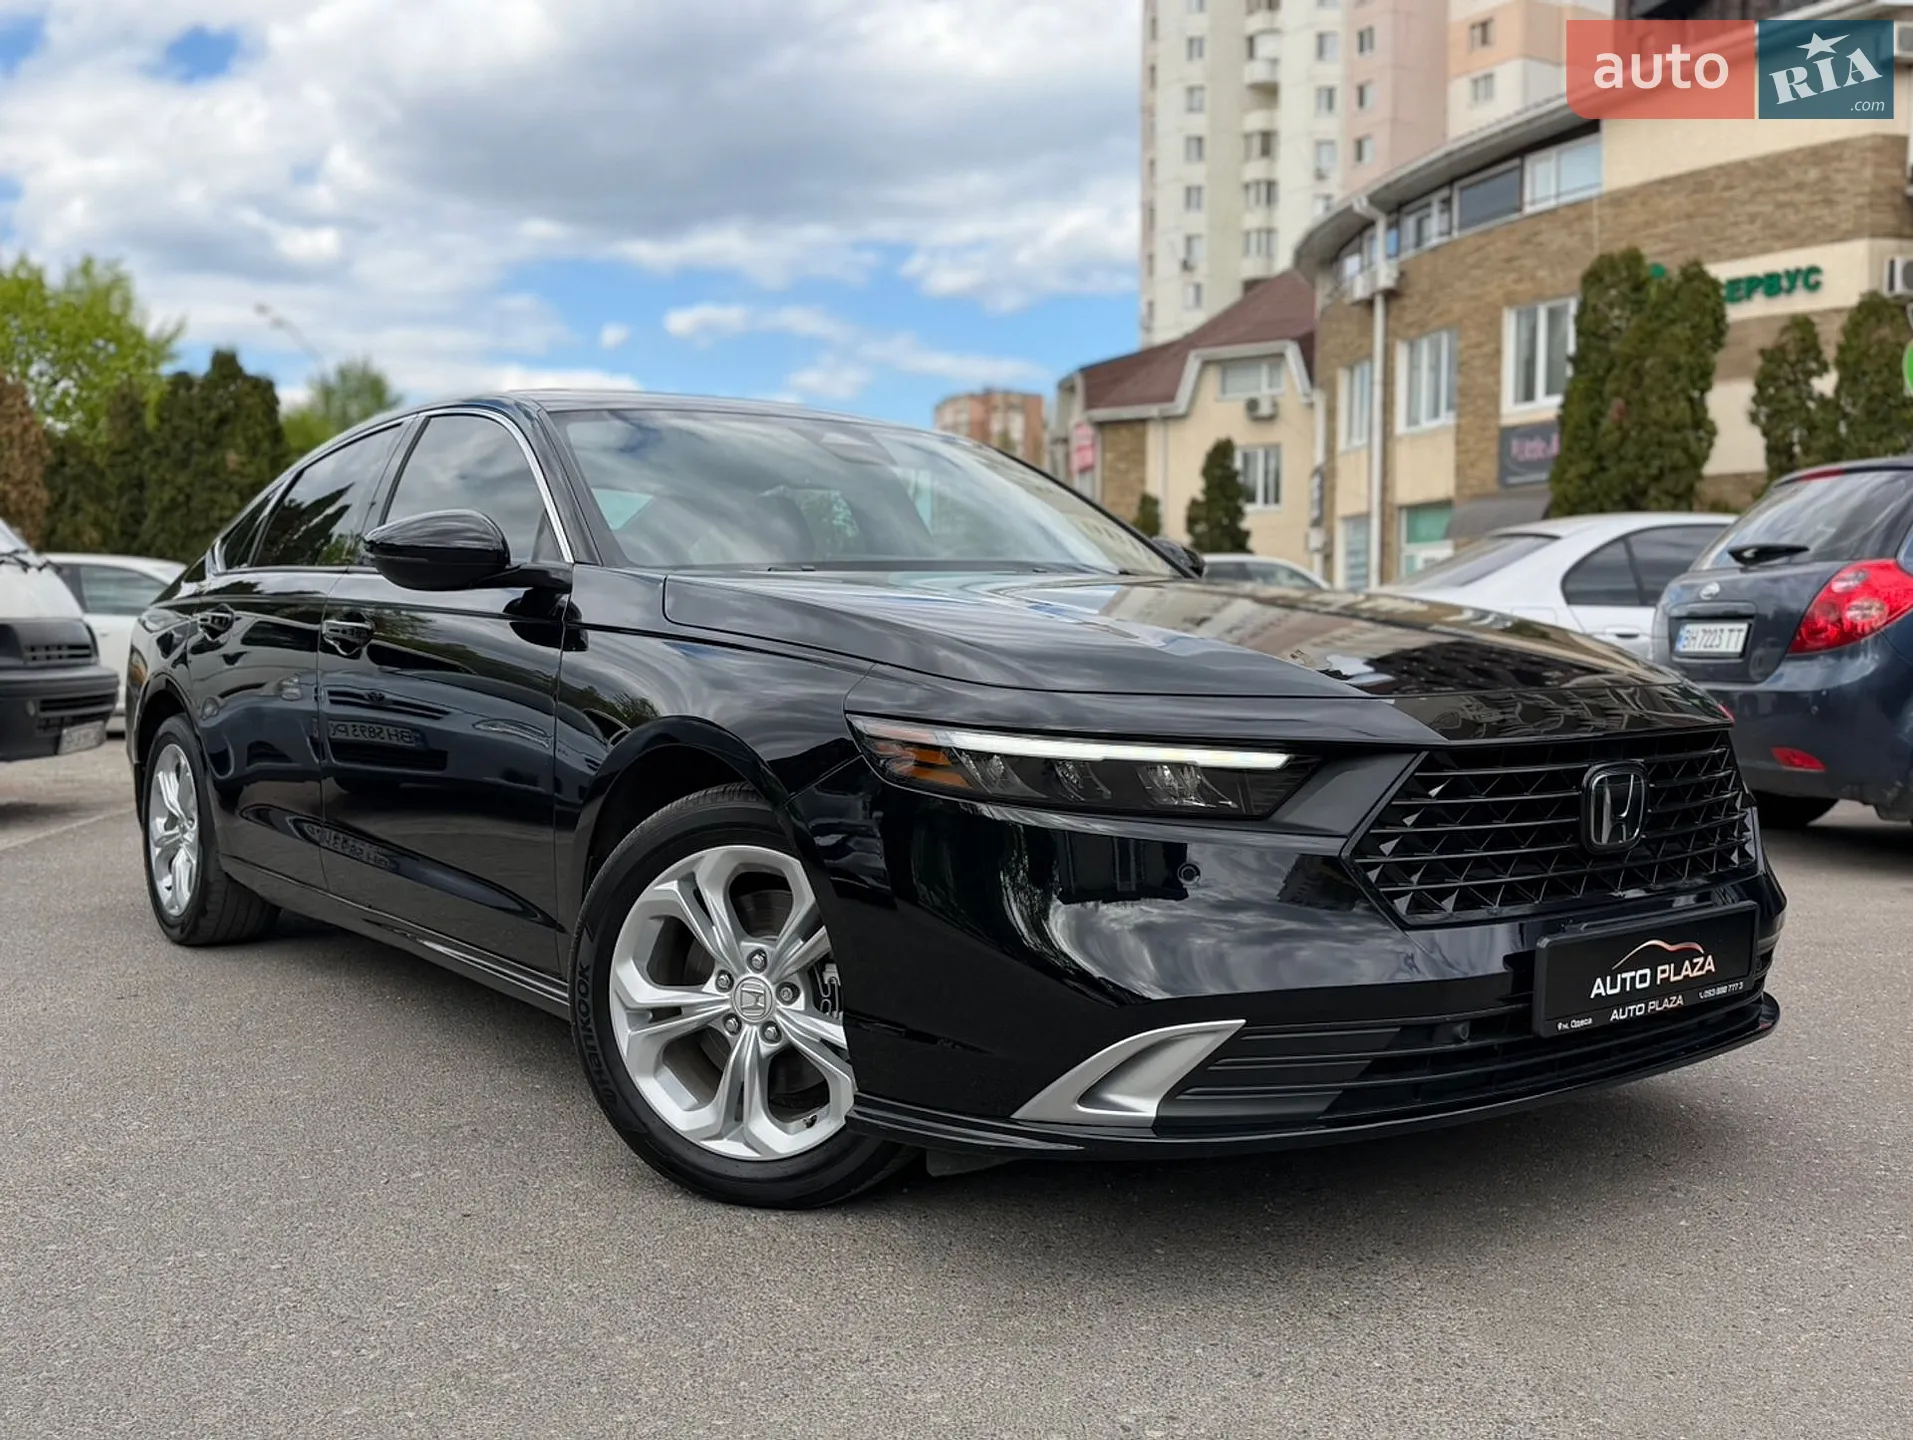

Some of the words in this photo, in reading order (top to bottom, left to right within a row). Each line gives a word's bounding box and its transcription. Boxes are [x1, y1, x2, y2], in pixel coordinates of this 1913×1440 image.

[1590, 968, 1650, 999] AUTO
[1656, 954, 1716, 985] PLAZA
[1610, 1003, 1645, 1021] AUTO
[1647, 994, 1684, 1012] PLAZA
